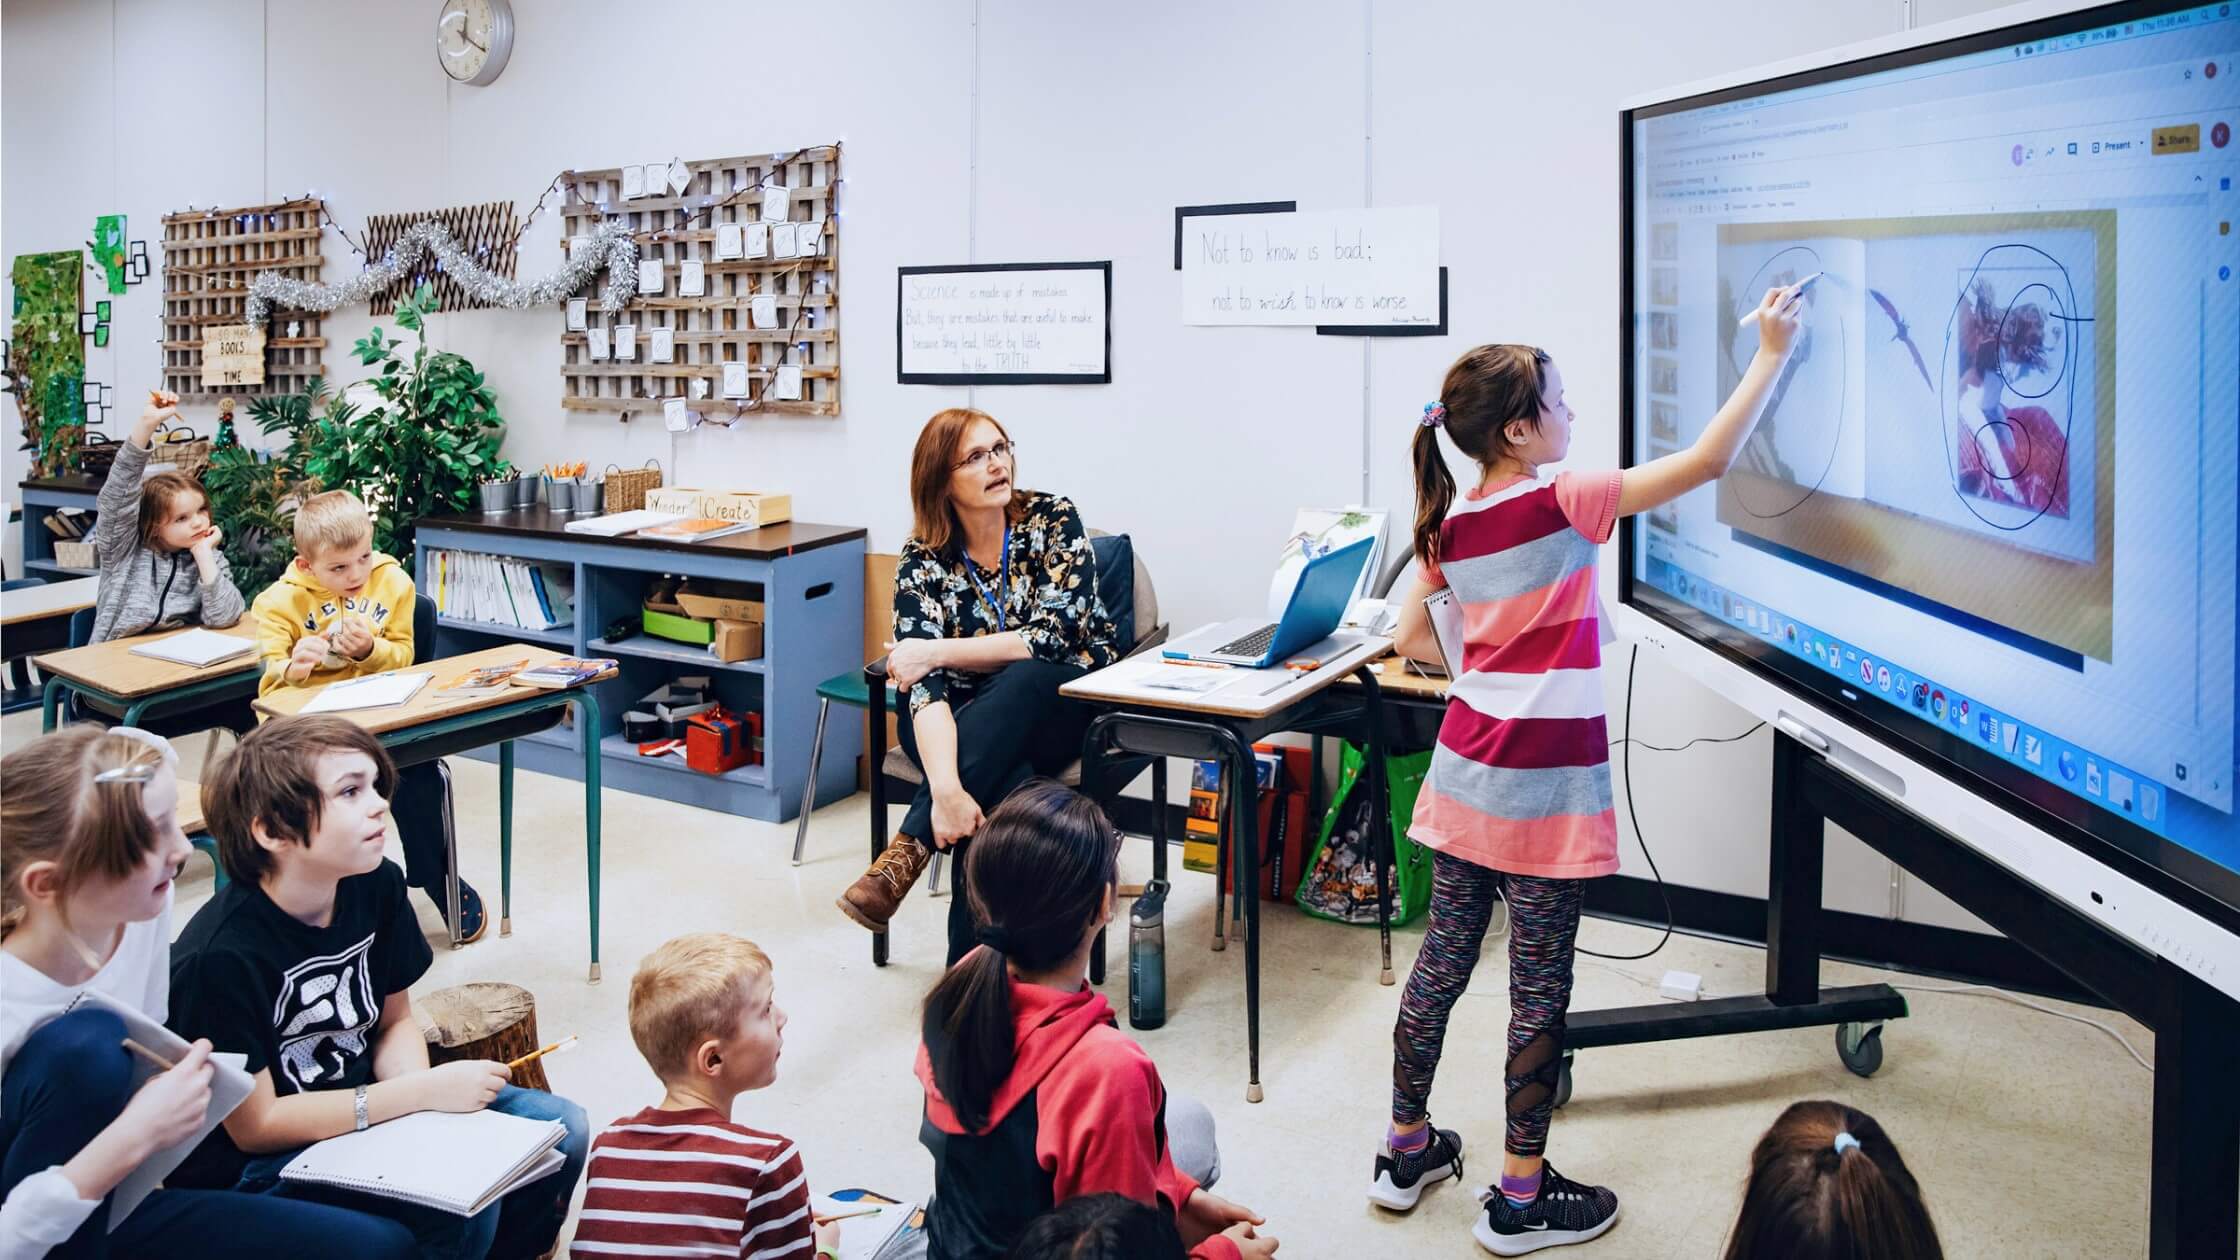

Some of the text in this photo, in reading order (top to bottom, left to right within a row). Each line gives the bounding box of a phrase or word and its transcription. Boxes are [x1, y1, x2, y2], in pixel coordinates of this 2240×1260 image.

[2177, 14, 2190, 25] AM
[2104, 141, 2130, 151] Present
[2169, 136, 2191, 145] Share
[1202, 231, 1230, 265] Not
[1240, 231, 1254, 263] to
[1264, 228, 1298, 262] know
[1308, 245, 1319, 261] is
[911, 281, 960, 302] Science
[979, 283, 1000, 298] made
[1003, 288, 1013, 302] up
[1016, 281, 1025, 298] of
[1212, 282, 1407, 311] not to wish to know is worse
[949, 314, 963, 325] are
[965, 310, 999, 325] mistakes
[1002, 309, 1017, 324] that
[1021, 315, 1033, 324] are
[1059, 311, 1067, 323] to
[1071, 308, 1094, 324] make
[1006, 332, 1017, 353] by
[994, 352, 1030, 370] TRUTH
[224, 370, 242, 384] TIME
